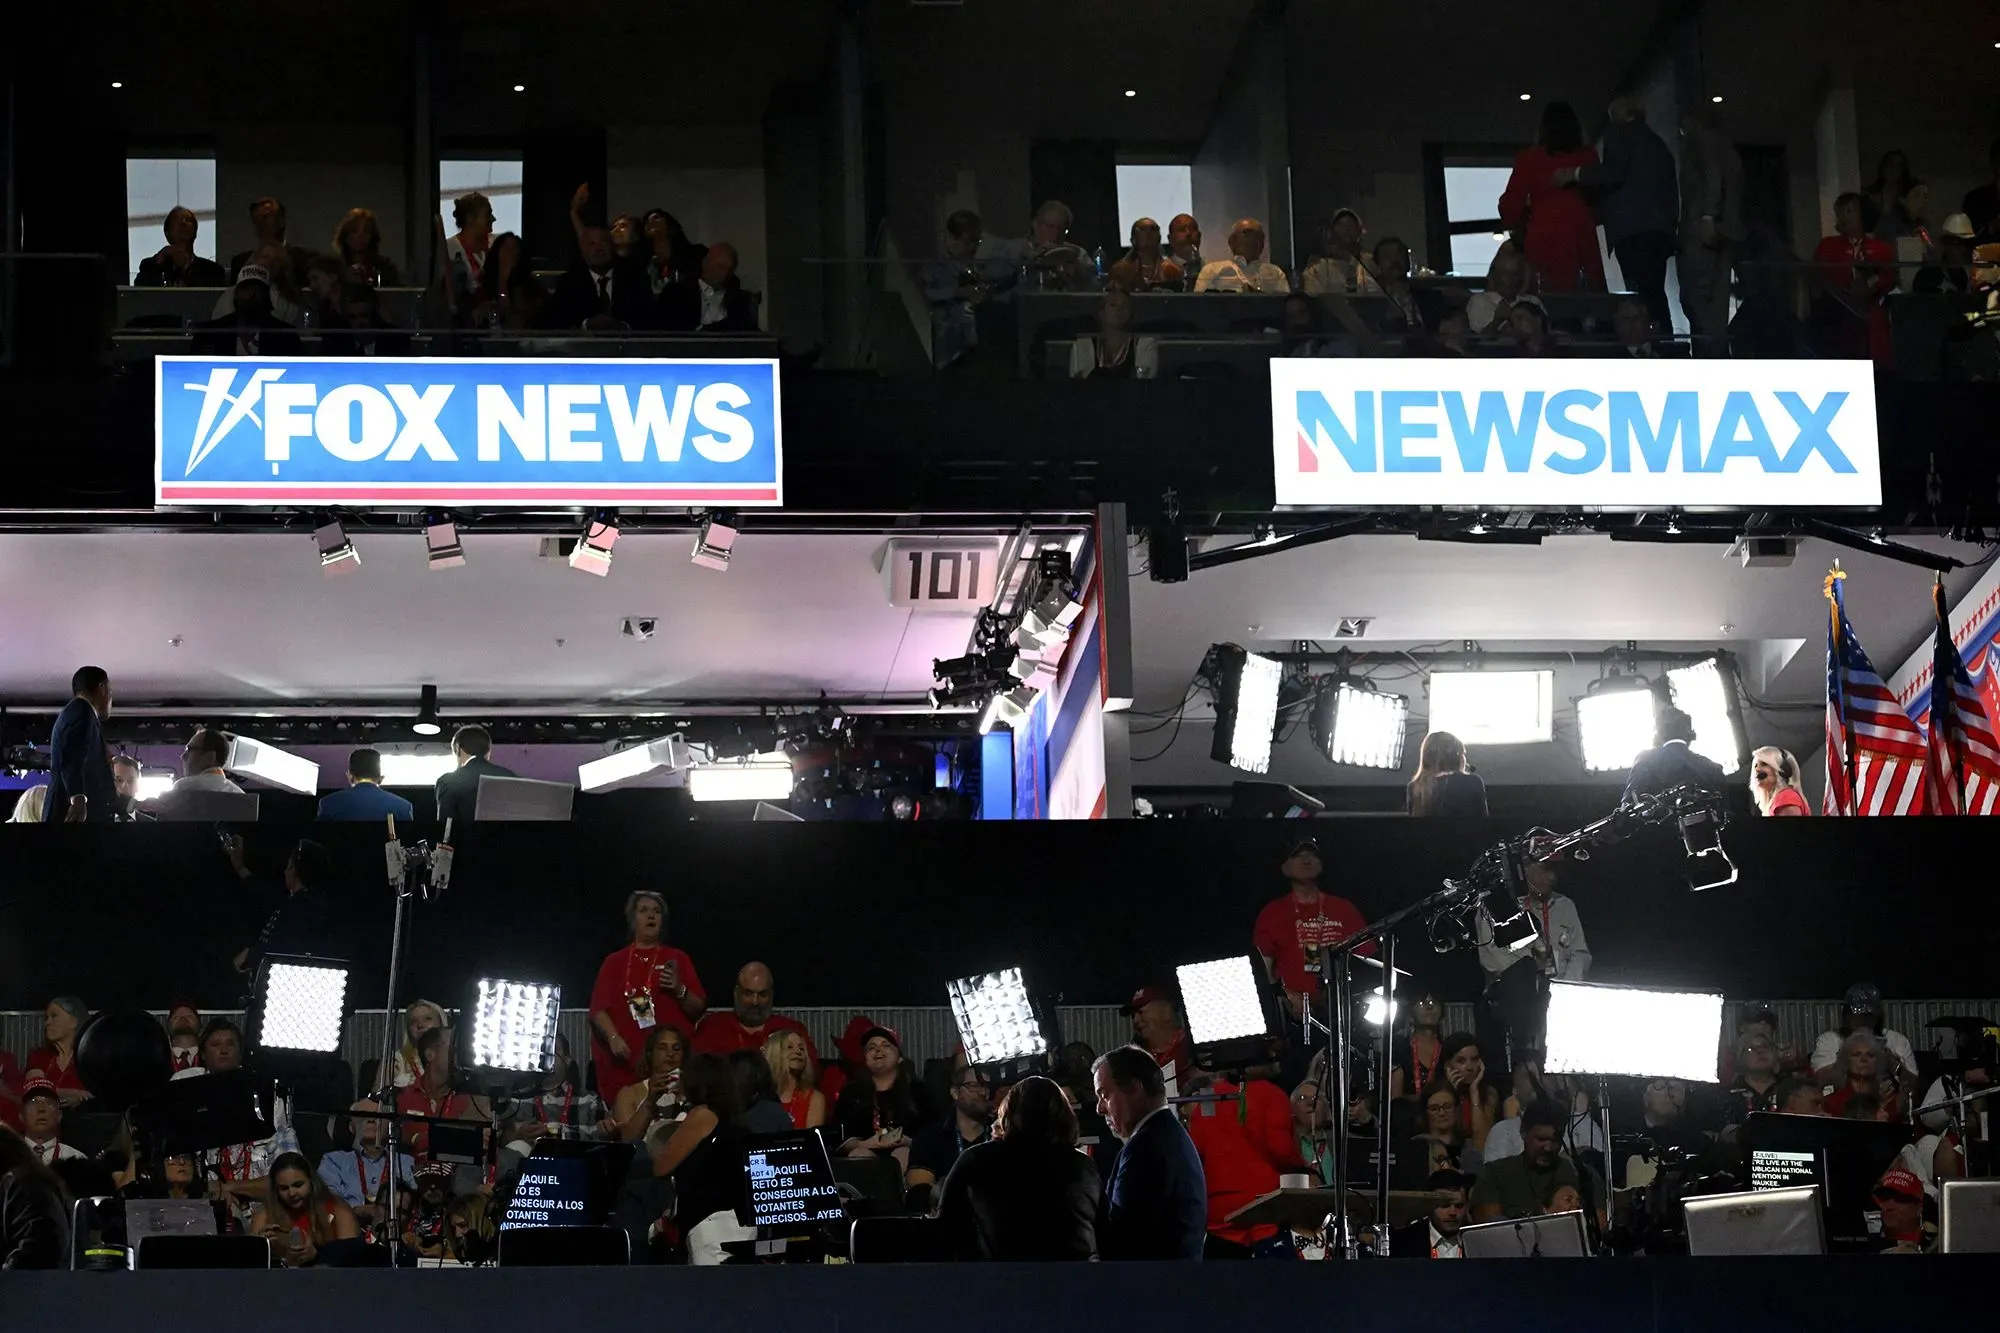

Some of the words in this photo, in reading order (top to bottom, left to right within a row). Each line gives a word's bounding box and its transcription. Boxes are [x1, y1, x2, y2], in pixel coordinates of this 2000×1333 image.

[265, 383, 460, 462] FOX
[477, 382, 755, 463] NEWS
[1295, 388, 1859, 475] NEWSMAX
[909, 551, 981, 600] 101
[750, 1158, 760, 1166] CR
[774, 1165, 798, 1175] AQUI
[800, 1163, 812, 1173] EL
[1781, 1167, 1813, 1175] NATIONAL
[524, 1174, 547, 1185] AQUI
[548, 1175, 560, 1185] EL
[752, 1178, 778, 1190] RETO
[780, 1177, 794, 1187] ES
[529, 1187, 541, 1196] ES
[753, 1187, 811, 1202] CONSEGUIR
[811, 1187, 820, 1197] A
[556, 1201, 564, 1209] A
[565, 1200, 584, 1210] LOS
[754, 1200, 805, 1214] VOTANTES
[816, 1209, 843, 1220] AYER
